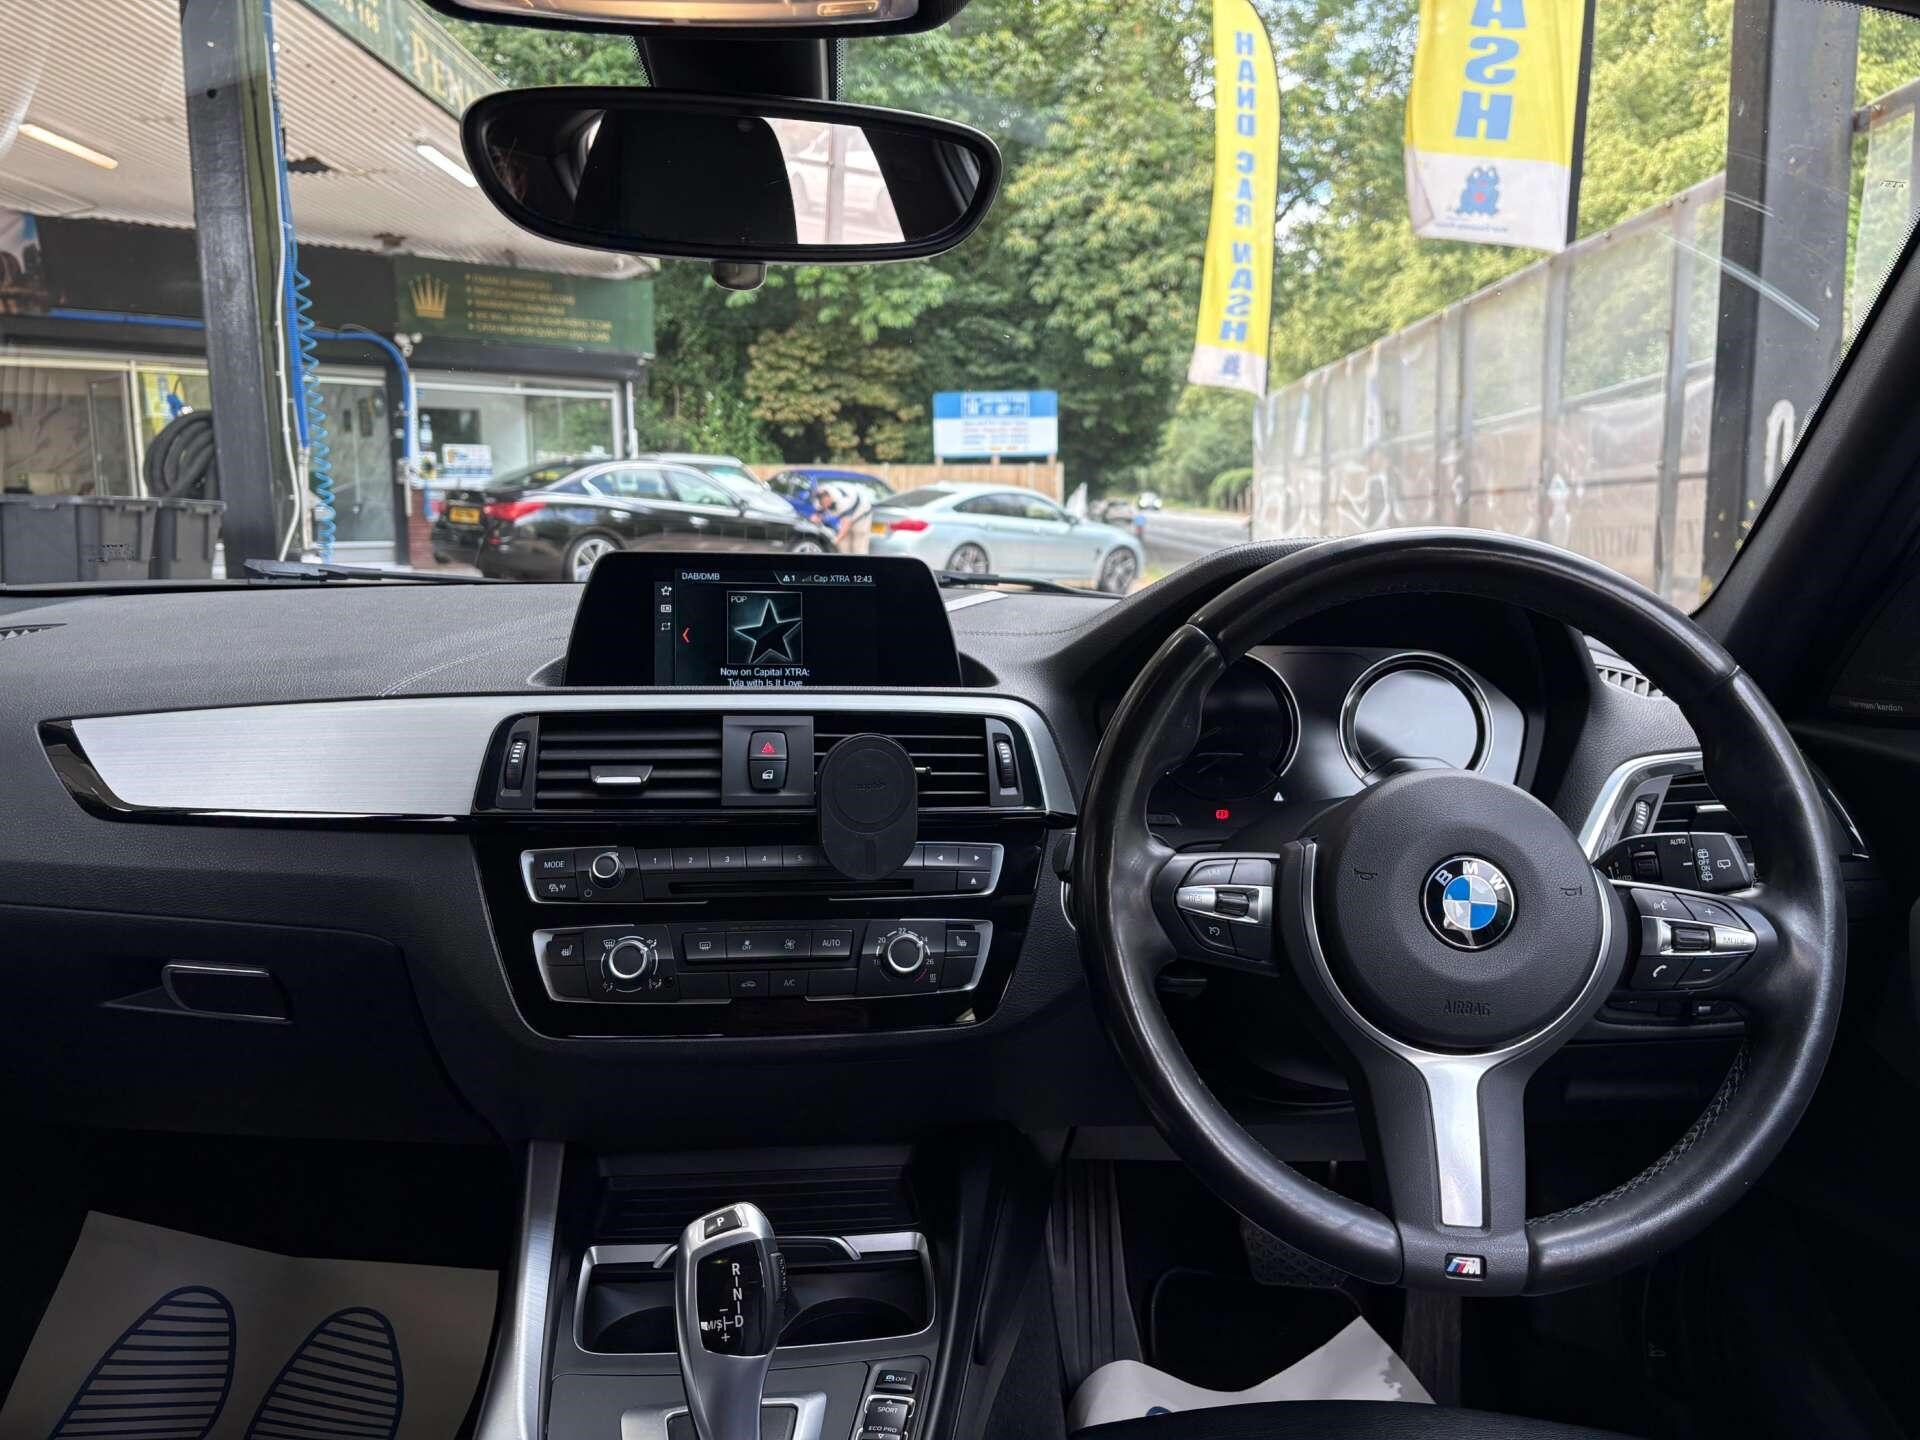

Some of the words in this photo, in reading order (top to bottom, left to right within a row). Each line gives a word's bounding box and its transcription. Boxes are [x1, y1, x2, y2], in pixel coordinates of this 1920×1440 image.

[681, 572, 720, 581] DAB/DMB
[813, 574, 828, 583] Cap
[830, 574, 850, 583] XTRA
[853, 574, 873, 583] 12:43
[730, 595, 748, 604] POP
[720, 667, 739, 676] Now
[740, 668, 752, 676] on
[754, 667, 783, 678] Capital
[784, 667, 811, 677] XTRA:
[727, 678, 744, 687] Tyla
[746, 678, 764, 687] with
[783, 678, 803, 687] Love
[544, 860, 565, 869] MODE
[1435, 861, 1506, 891] BMW
[822, 939, 841, 947] AUTO
[877, 936, 887, 944] 20
[783, 978, 796, 988] A/C
[717, 1216, 725, 1227] P
[731, 1262, 741, 1276] R
[732, 1287, 743, 1301] N
[734, 1314, 744, 1328] D
[877, 1406, 899, 1414] SPORT
